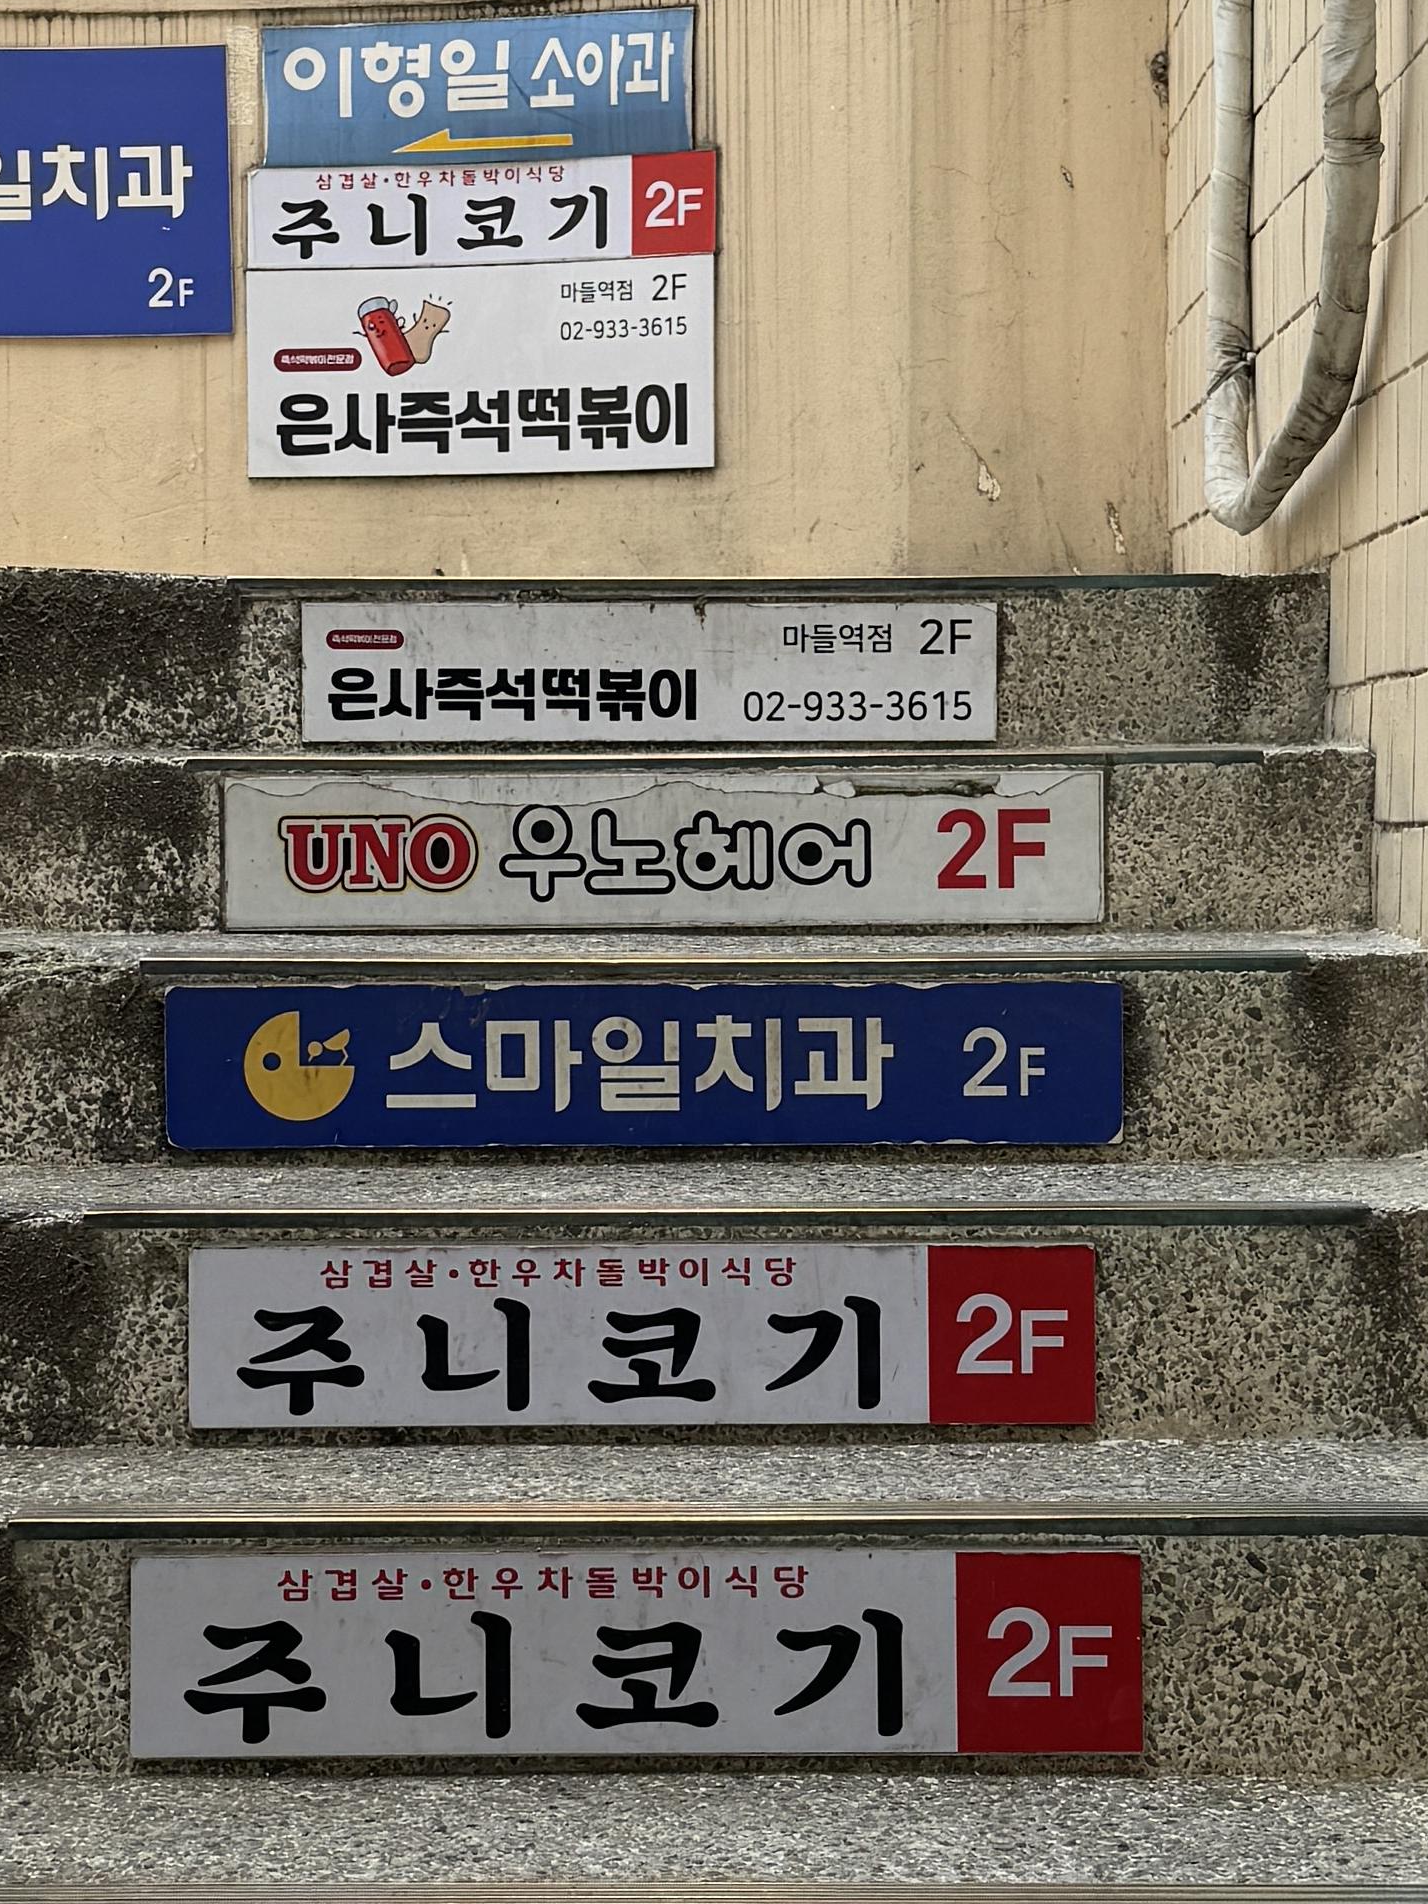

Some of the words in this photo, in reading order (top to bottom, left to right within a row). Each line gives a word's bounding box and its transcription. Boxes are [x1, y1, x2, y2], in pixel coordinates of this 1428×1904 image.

[281, 37, 509, 119] 이형일
[529, 30, 674, 107] 소아과
[271, 184, 608, 260] 주니코기
[644, 181, 702, 228] 2F
[148, 269, 194, 308] 2F
[560, 278, 634, 303] 마들역점
[652, 274, 687, 302] 2F
[559, 314, 688, 341] 02-933-3615
[275, 382, 689, 457] 은사즉석떡볶이
[782, 622, 893, 655] 마들역점
[919, 619, 973, 655] 2F
[327, 666, 698, 722] 은사즉석떡볶이
[743, 690, 973, 723] 02-933-3615
[278, 813, 478, 894] UNO
[498, 804, 873, 903] 우노헤어
[936, 808, 1052, 891] 2F
[385, 1013, 895, 1114] 스마일치과
[962, 1026, 1045, 1098] 2F
[235, 1295, 884, 1417] 주니코기
[955, 1293, 1069, 1376] 2F
[183, 1608, 904, 1744] 주니코기
[986, 1605, 1113, 1698] 2F
